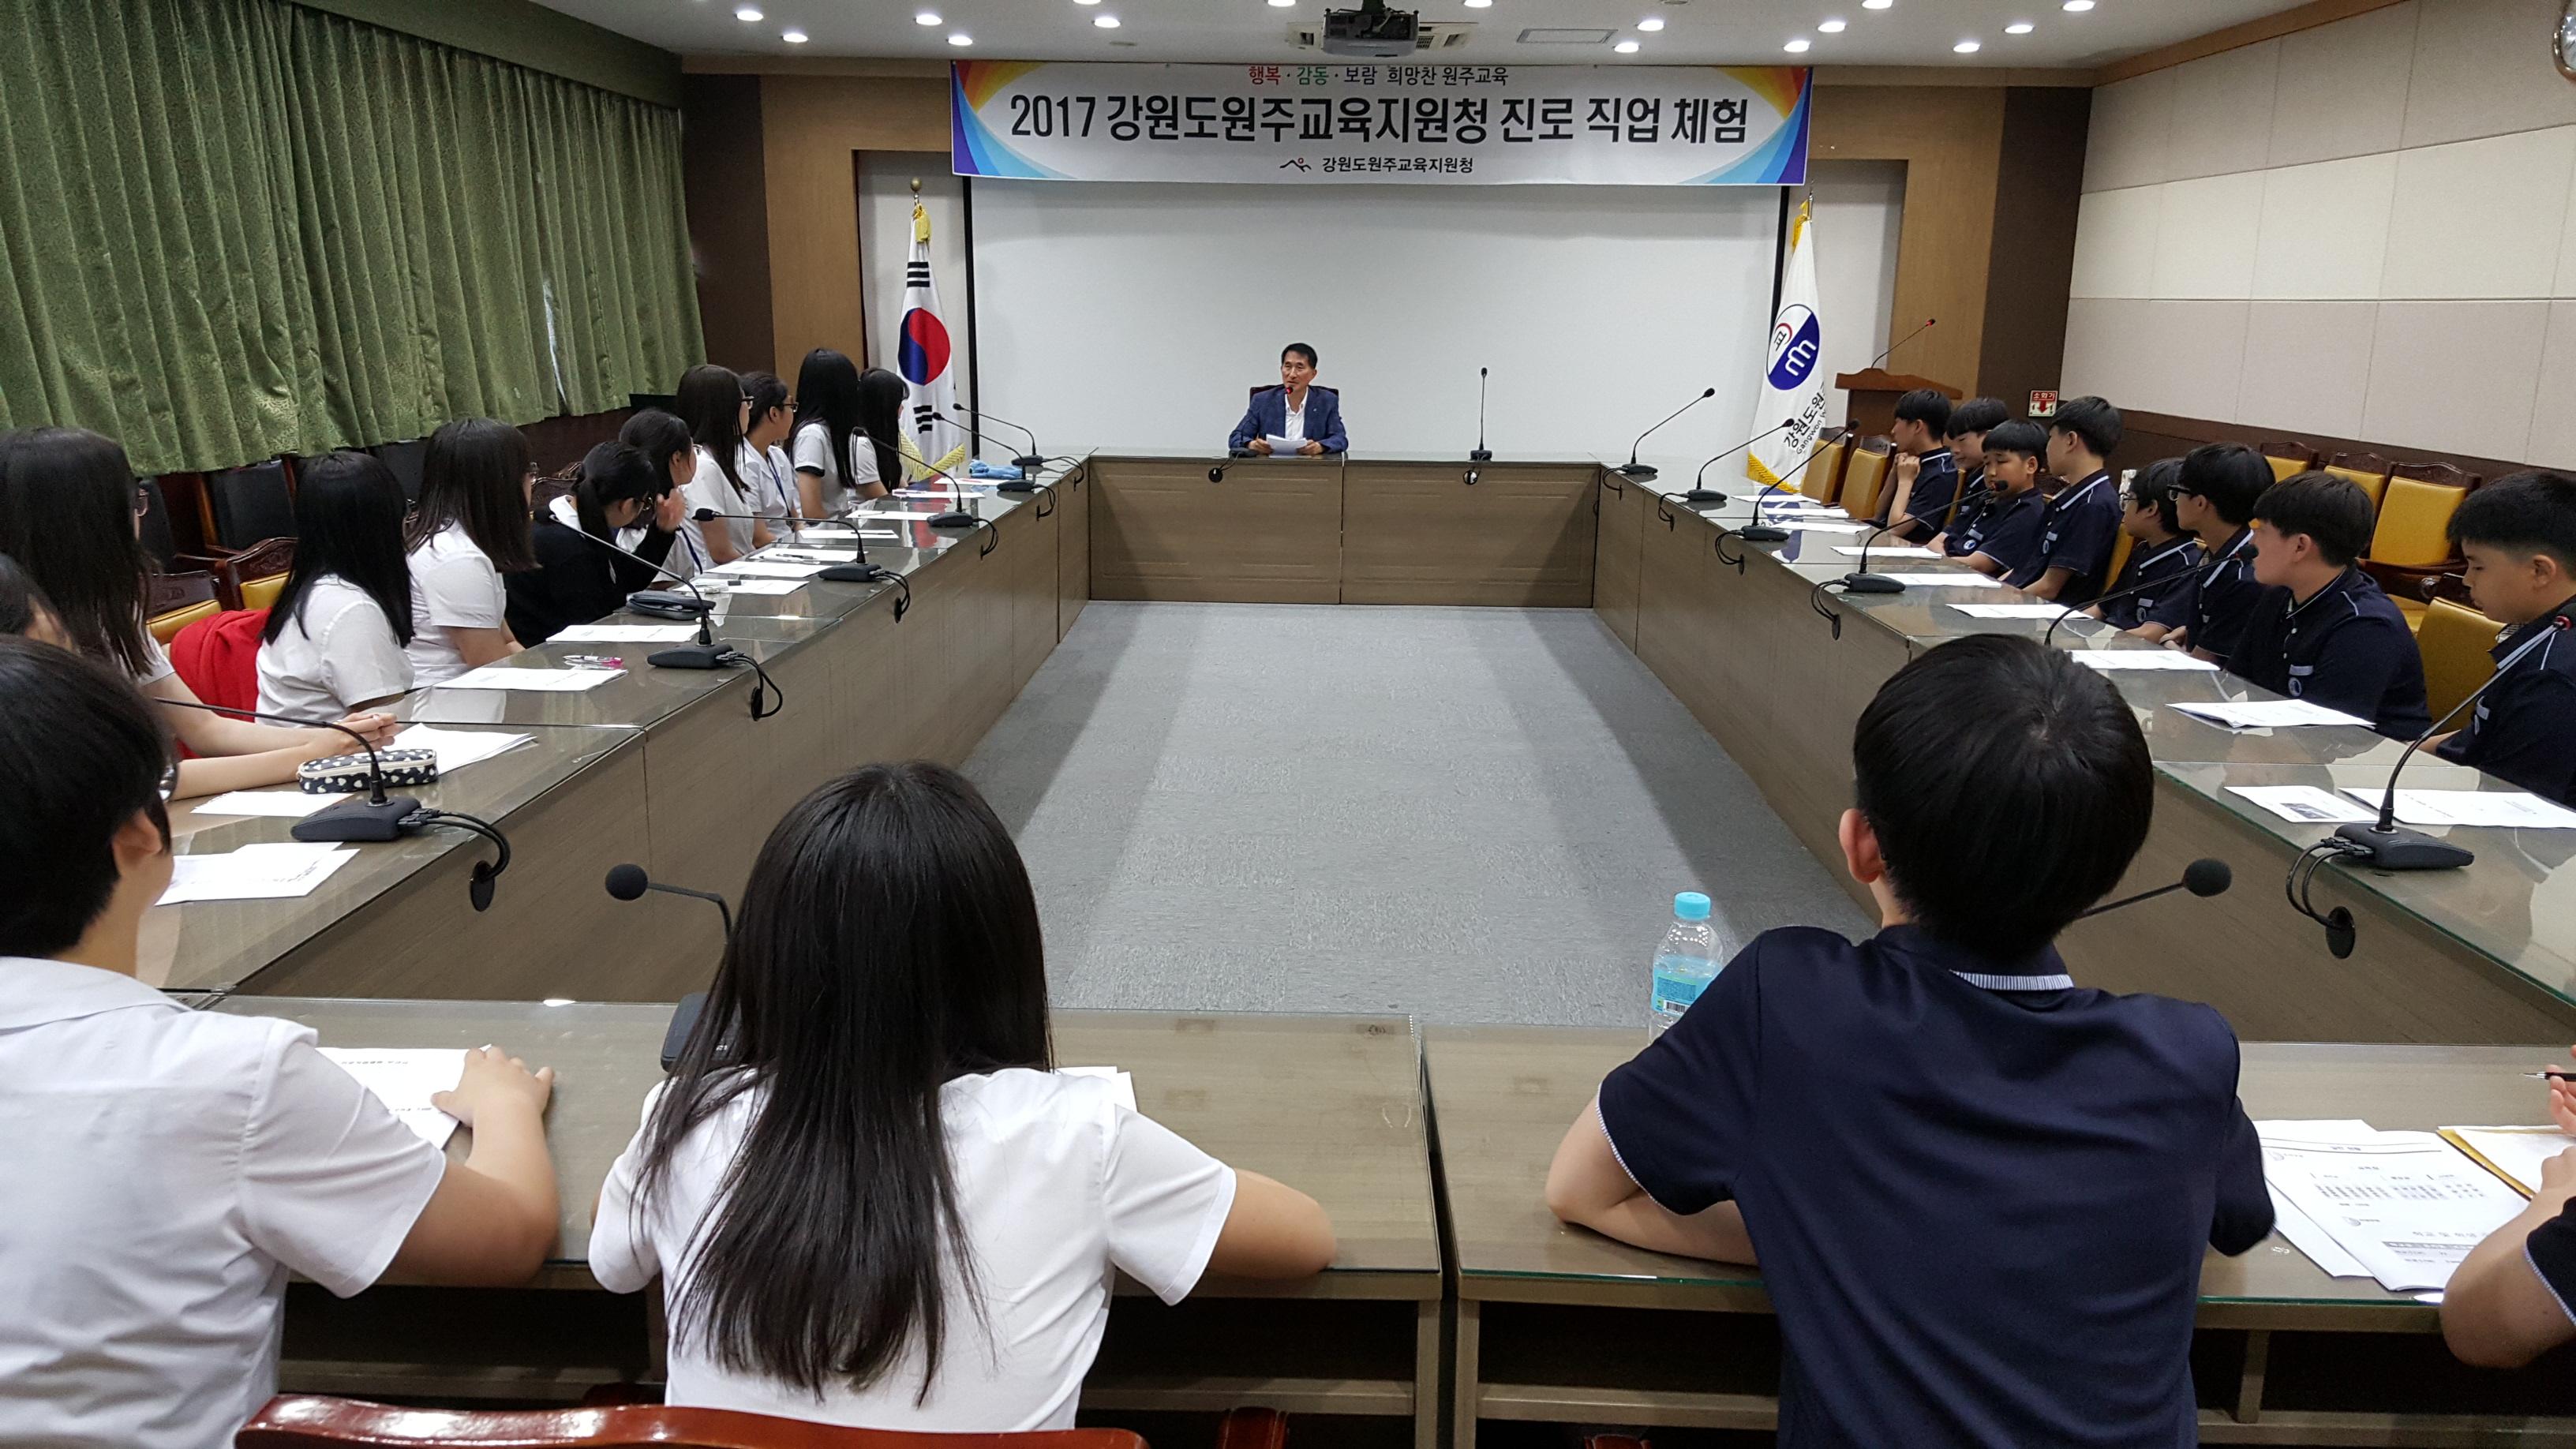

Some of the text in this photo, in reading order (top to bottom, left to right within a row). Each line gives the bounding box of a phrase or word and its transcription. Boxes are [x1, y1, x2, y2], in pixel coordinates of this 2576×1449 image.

[1249, 66, 1509, 86] 행복 감동 보람 희망찬 원주교육
[1011, 94, 1748, 144] 2017 강원도원주교육지원청 진로 직업 체험
[1322, 156, 1473, 174] 강원도원주교육지원청
[1784, 381, 1825, 448] 강원도원
[1796, 419, 1822, 455] Gangwon
